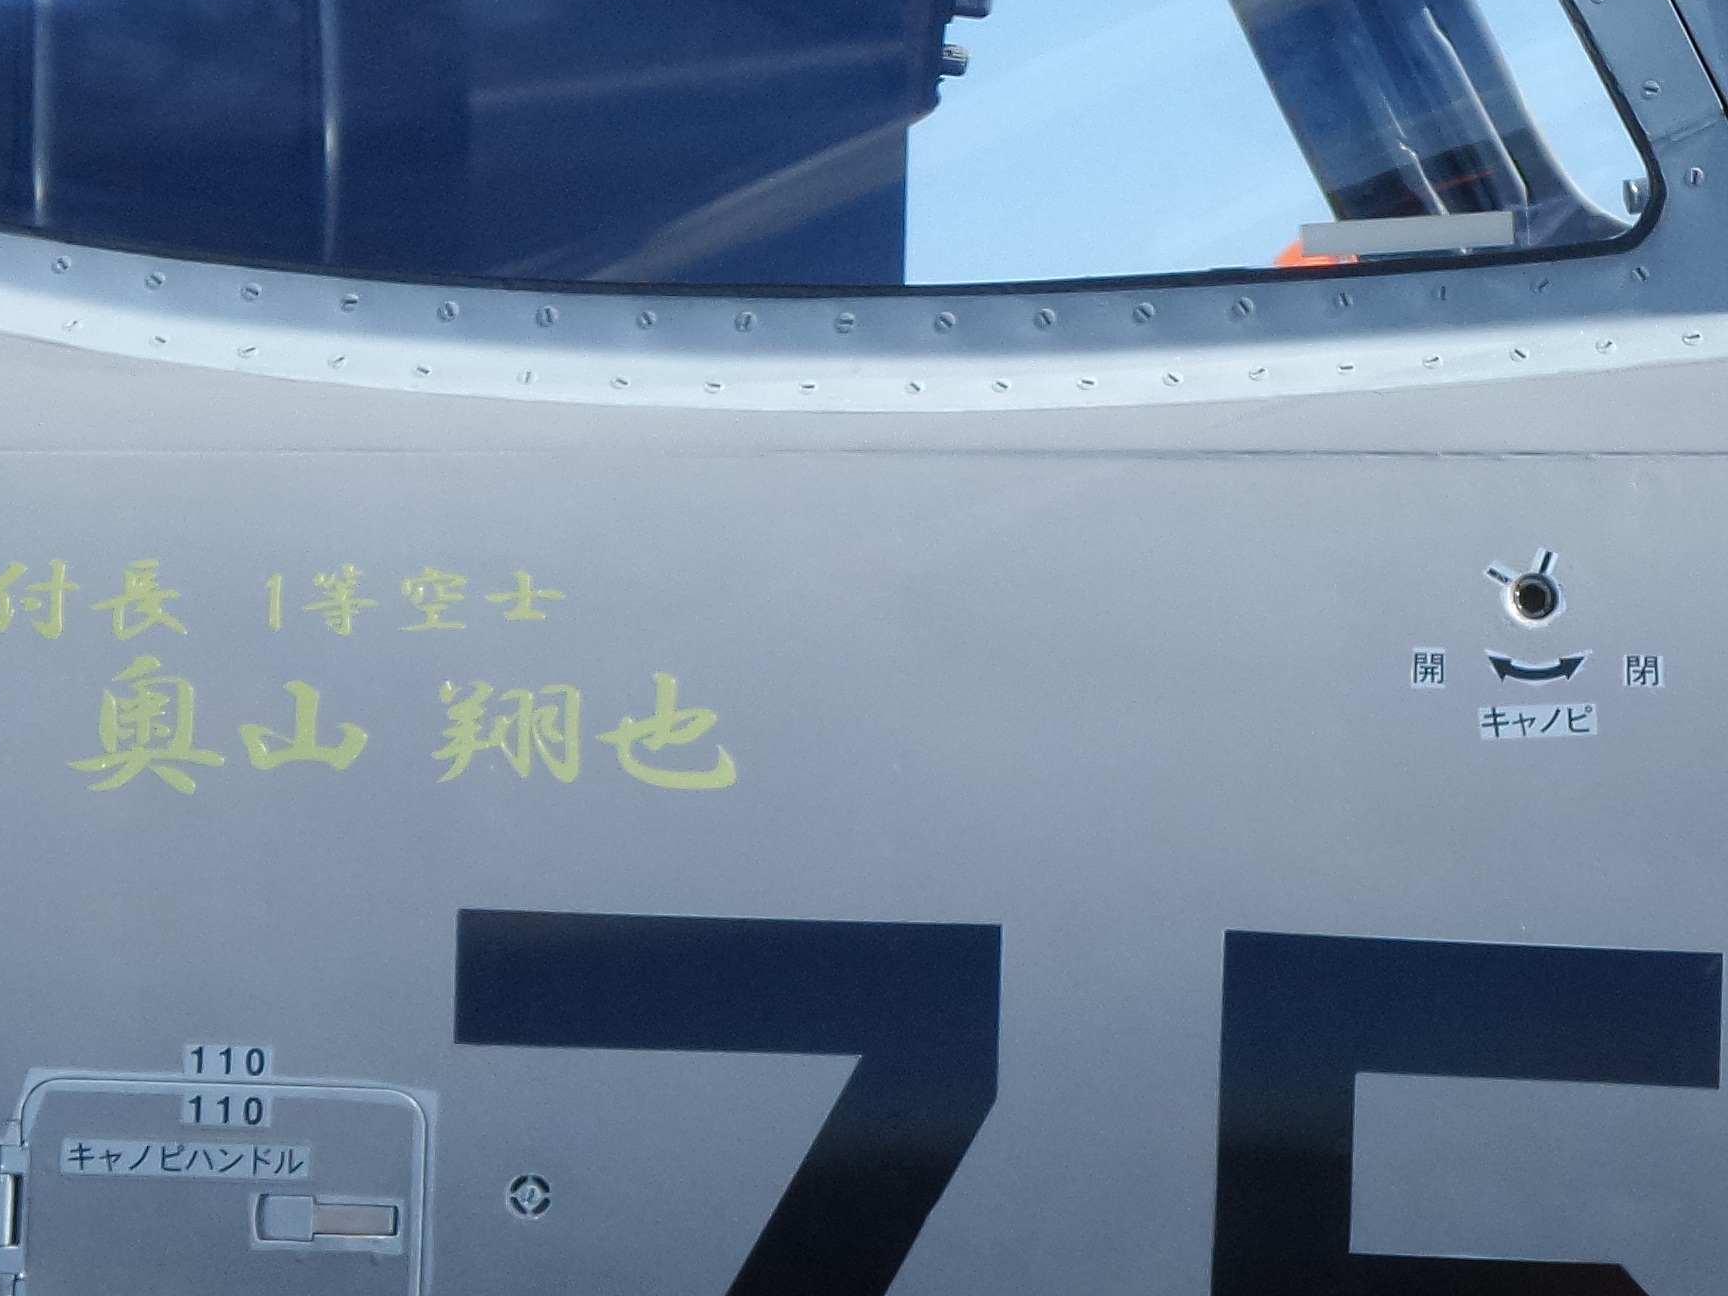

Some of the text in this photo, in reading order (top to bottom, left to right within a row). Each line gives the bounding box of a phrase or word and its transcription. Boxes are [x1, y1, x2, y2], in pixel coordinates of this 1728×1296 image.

[1412, 652, 1445, 684] 開
[1625, 654, 1661, 686] 閉
[66, 655, 737, 796] 奥山 翔也
[1480, 705, 1593, 738] キャノピ
[190, 1045, 266, 1077] 110
[188, 1094, 264, 1125] 110
[67, 1141, 305, 1176] キャノピハンドル
